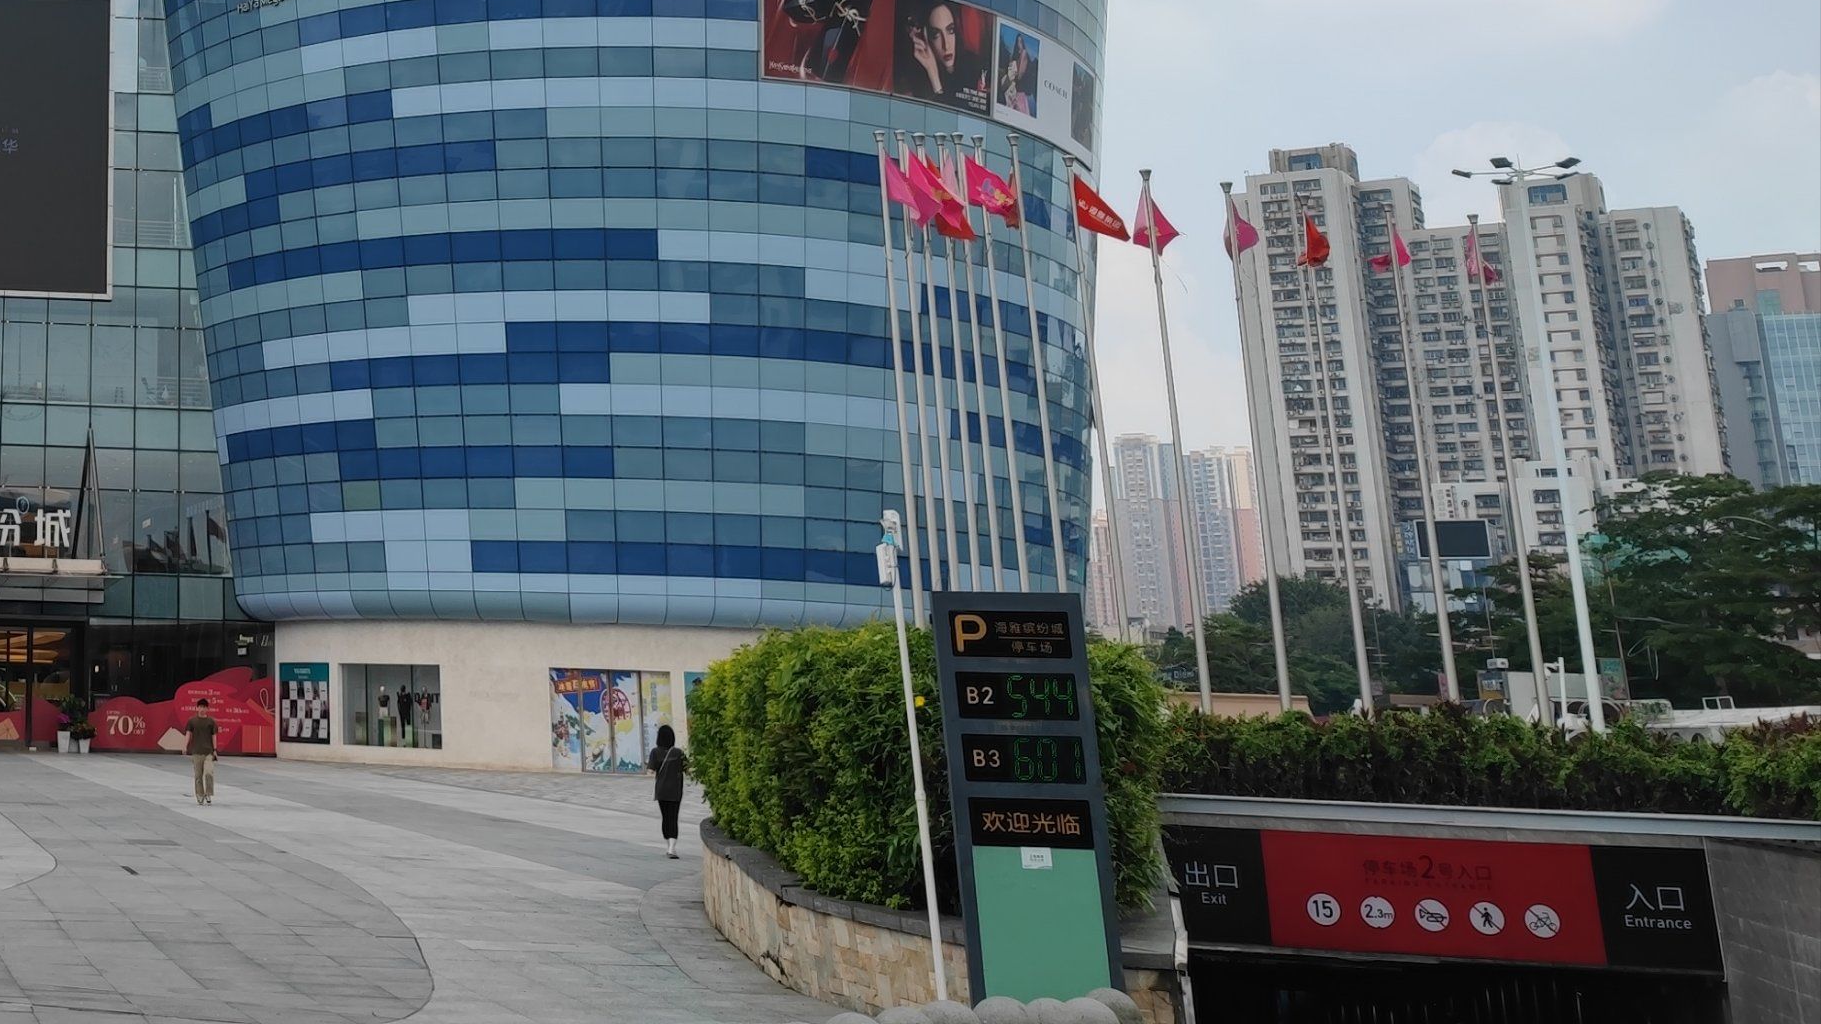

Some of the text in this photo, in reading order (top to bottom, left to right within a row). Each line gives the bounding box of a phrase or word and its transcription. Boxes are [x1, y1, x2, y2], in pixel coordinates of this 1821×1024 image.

[954, 614, 987, 653] P
[994, 621, 1064, 636] 海雅缤纷城
[1011, 641, 1053, 655] 停车场
[966, 686, 995, 705] B2
[1007, 675, 1074, 719] 544
[972, 749, 1001, 768] B3
[1013, 737, 1081, 782] 601
[982, 811, 1081, 836] 欢迎光临
[1185, 860, 1239, 889] 出口
[1201, 891, 1227, 906] Exit
[1626, 883, 1685, 911] 入口
[1312, 899, 1334, 919] 15
[1364, 904, 1394, 920] 2.3m
[1624, 914, 1693, 930] Entrance
